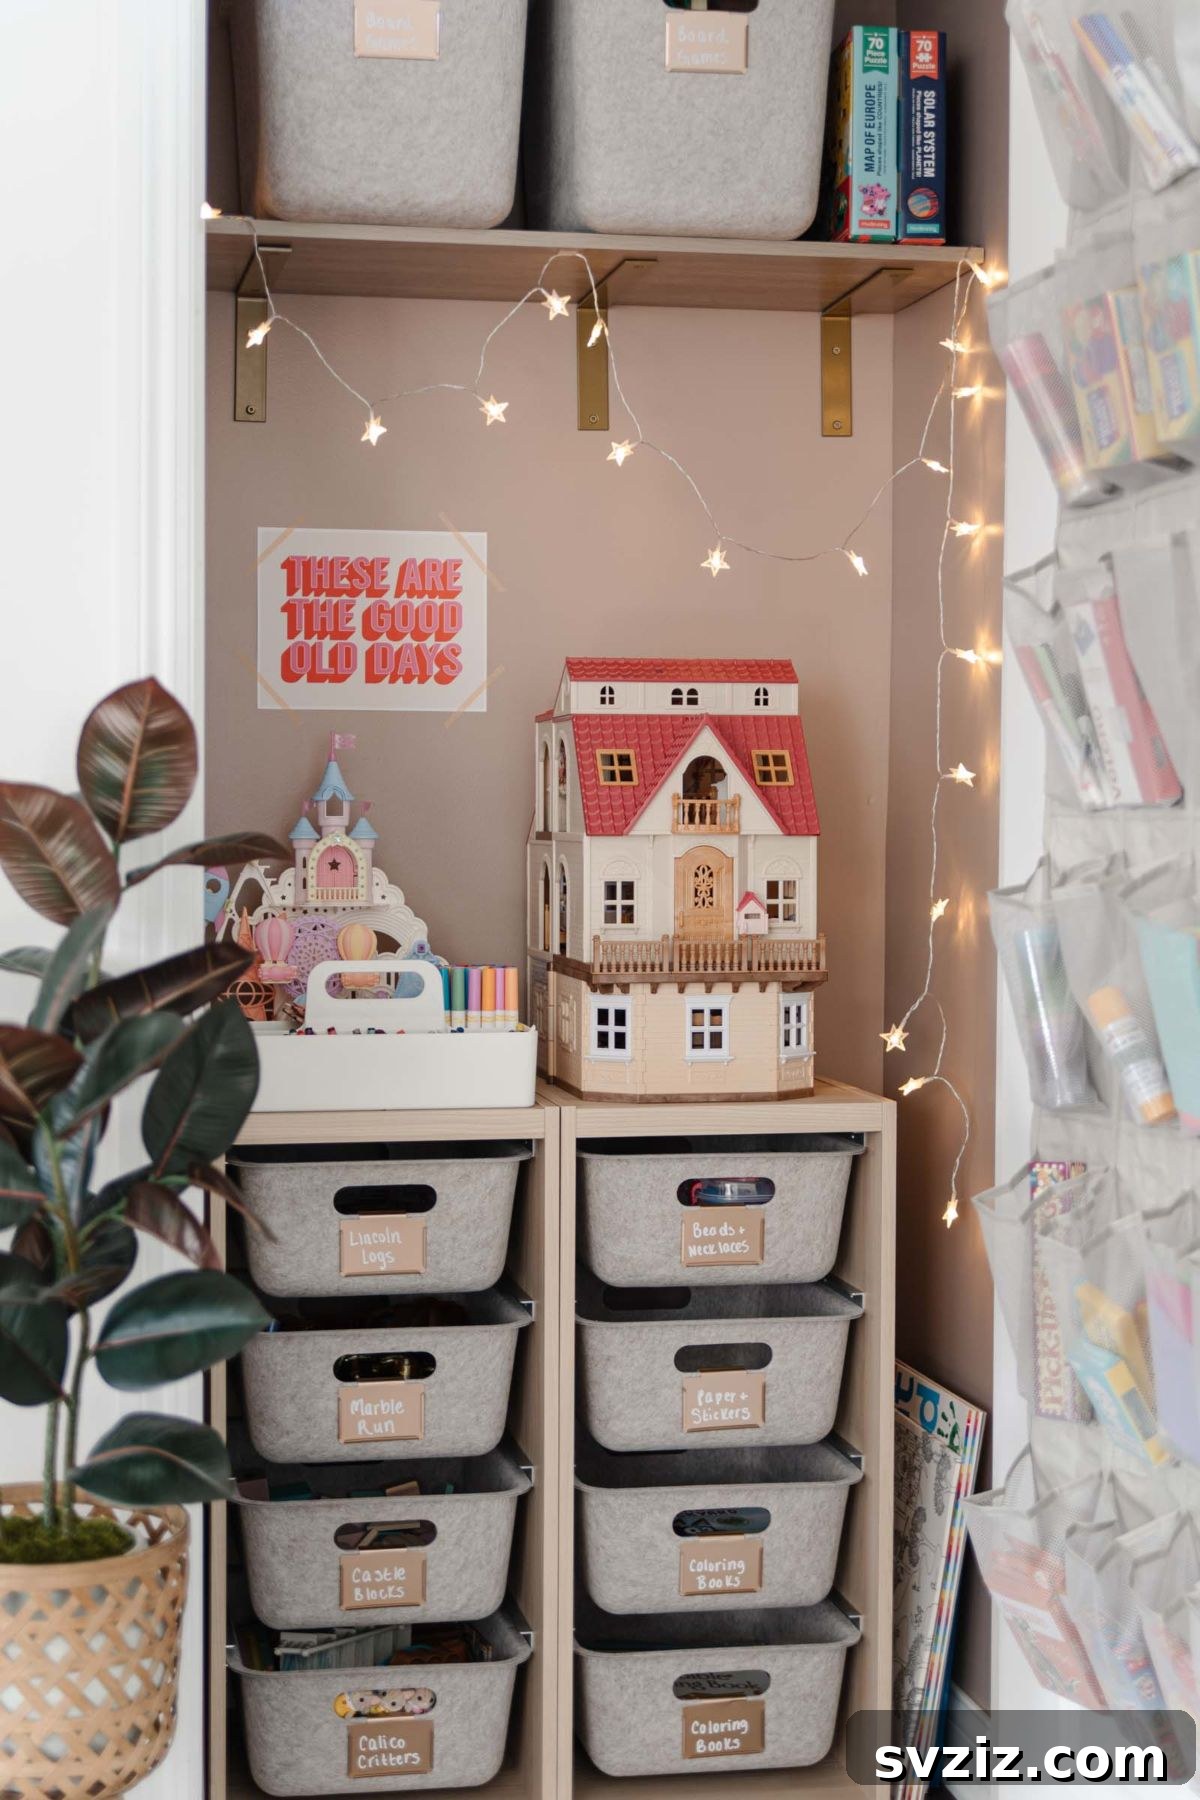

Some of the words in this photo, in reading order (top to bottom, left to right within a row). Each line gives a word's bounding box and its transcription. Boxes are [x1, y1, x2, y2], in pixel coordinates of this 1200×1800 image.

[867, 37, 884, 50] 70
[915, 40, 932, 52] 70
[864, 56, 887, 64] Puzzle
[912, 62, 936, 70] Puzzle
[864, 84, 876, 129] EUROPE
[923, 90, 936, 128] SOLAR
[864, 131, 875, 146] OF
[864, 147, 875, 173] MAP
[923, 131, 935, 178] SYSTEM
[281, 555, 391, 598] THESE
[394, 557, 463, 600] ARE
[281, 598, 357, 640] THE
[361, 600, 463, 642] GOOD
[281, 641, 358, 683] OLD
[365, 642, 463, 685] DAYS
[349, 1225, 402, 1247] Lincoln
[692, 1221, 736, 1238] Beads
[696, 1388, 736, 1406] Paper
[350, 1397, 405, 1416] Marble
[690, 1407, 752, 1424] Stickers
[357, 1418, 396, 1436] Run
[351, 1565, 407, 1583] Castle
[688, 1558, 746, 1575] Coloring
[695, 1574, 742, 1591] Books
[353, 1584, 406, 1602] Blocks
[691, 1718, 749, 1735] Coloring
[358, 1734, 406, 1752] Calico
[695, 1736, 742, 1753] Books
[357, 1751, 421, 1770] Critters
